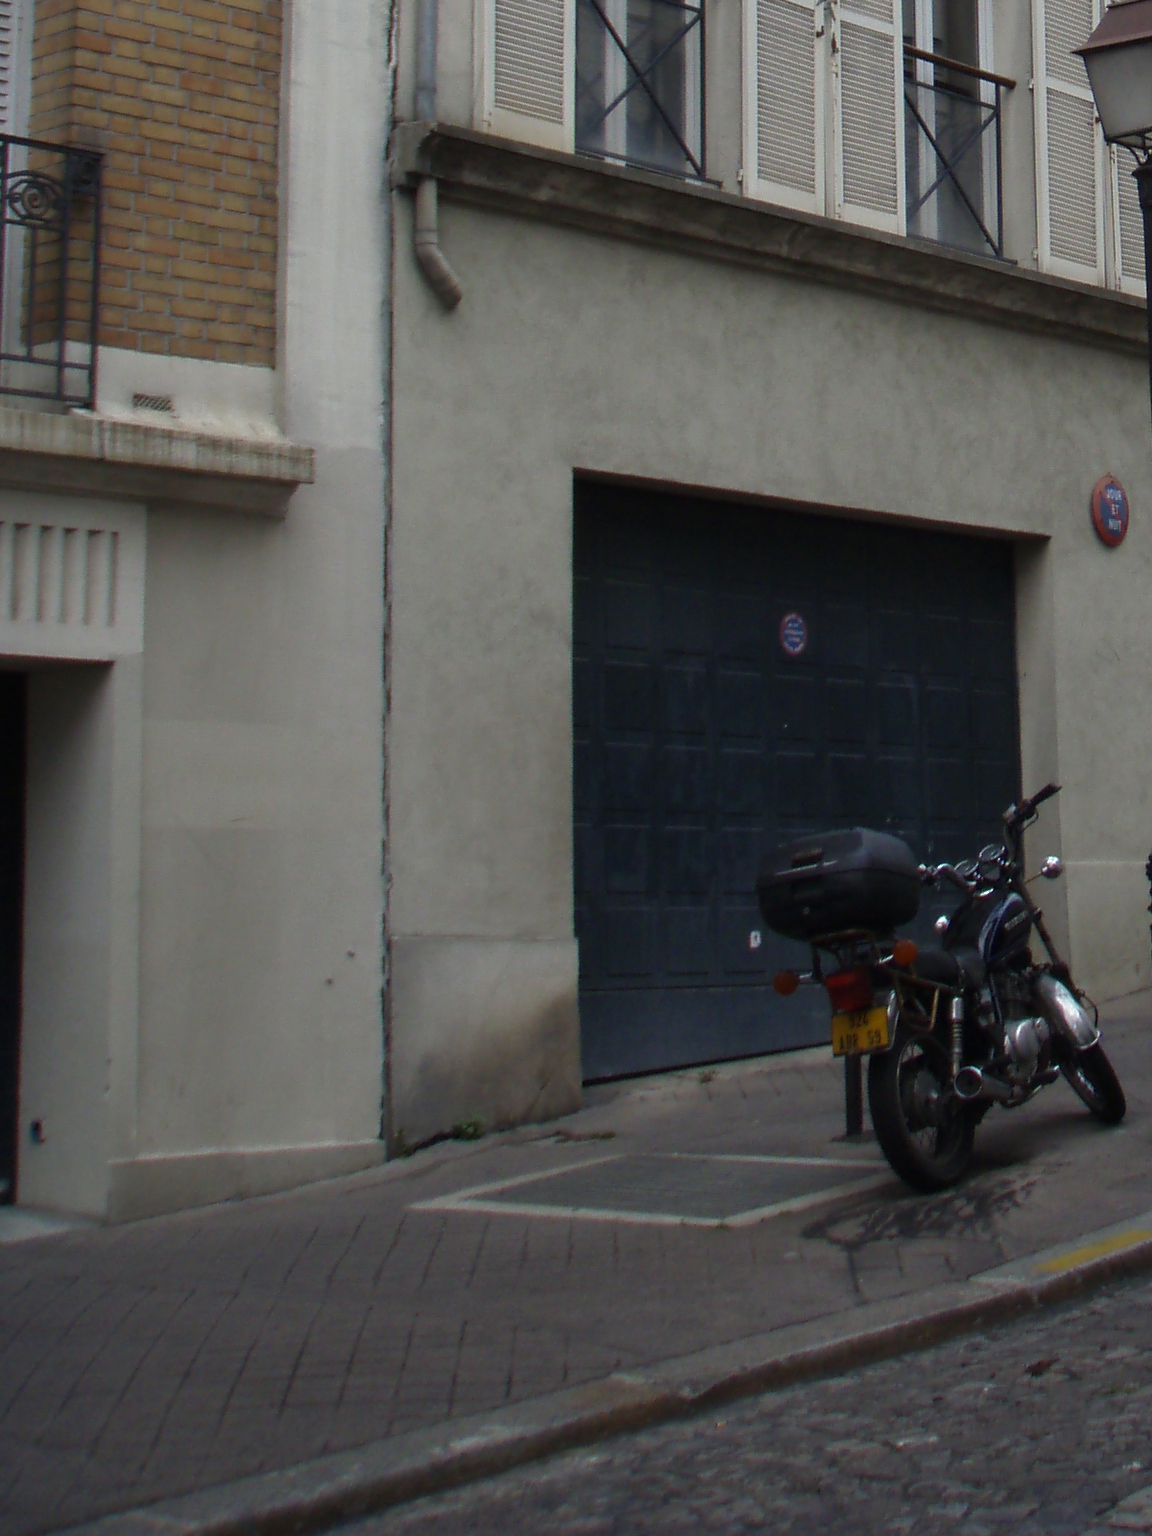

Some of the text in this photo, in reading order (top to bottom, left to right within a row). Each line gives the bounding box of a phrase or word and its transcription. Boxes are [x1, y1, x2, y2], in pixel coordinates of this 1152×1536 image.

[1106, 488, 1122, 501] JOUR
[1111, 504, 1119, 515] ET
[1108, 518, 1122, 531] NUIT
